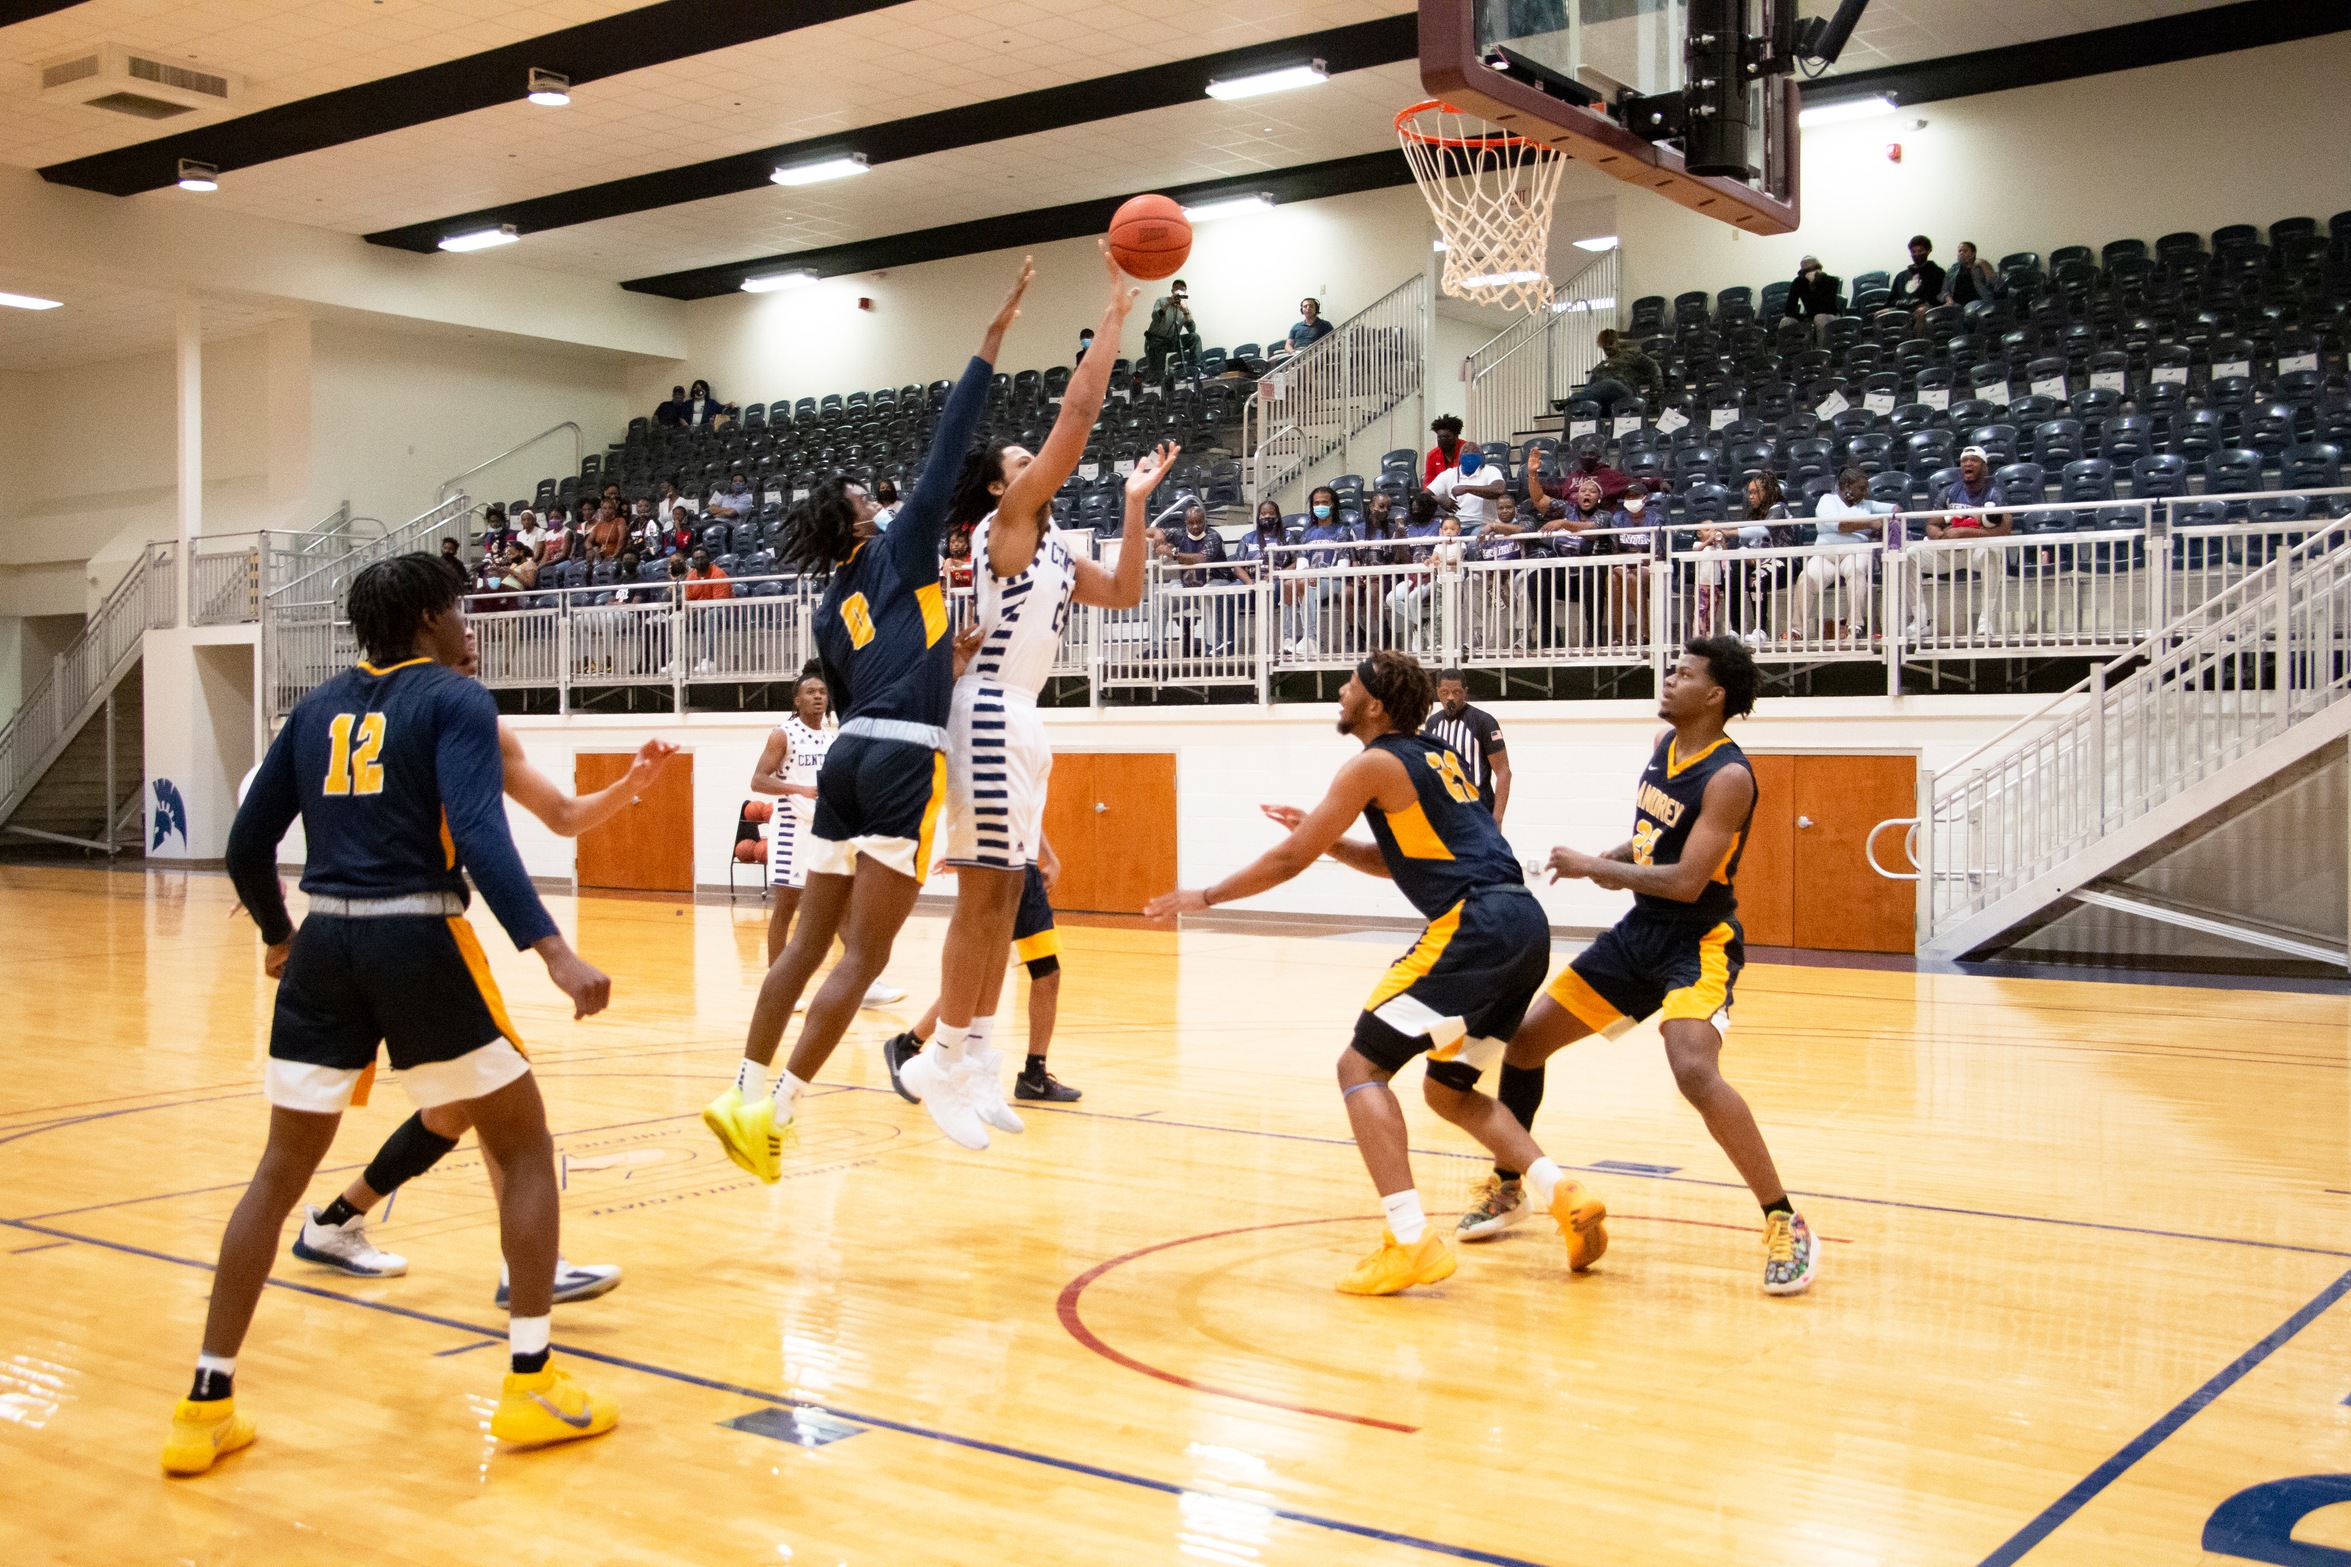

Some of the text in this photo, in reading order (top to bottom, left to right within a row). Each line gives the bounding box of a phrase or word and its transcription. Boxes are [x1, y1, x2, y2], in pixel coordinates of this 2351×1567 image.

[840, 591, 877, 651] 0
[322, 711, 387, 796] 12
[798, 753, 826, 767] CENT
